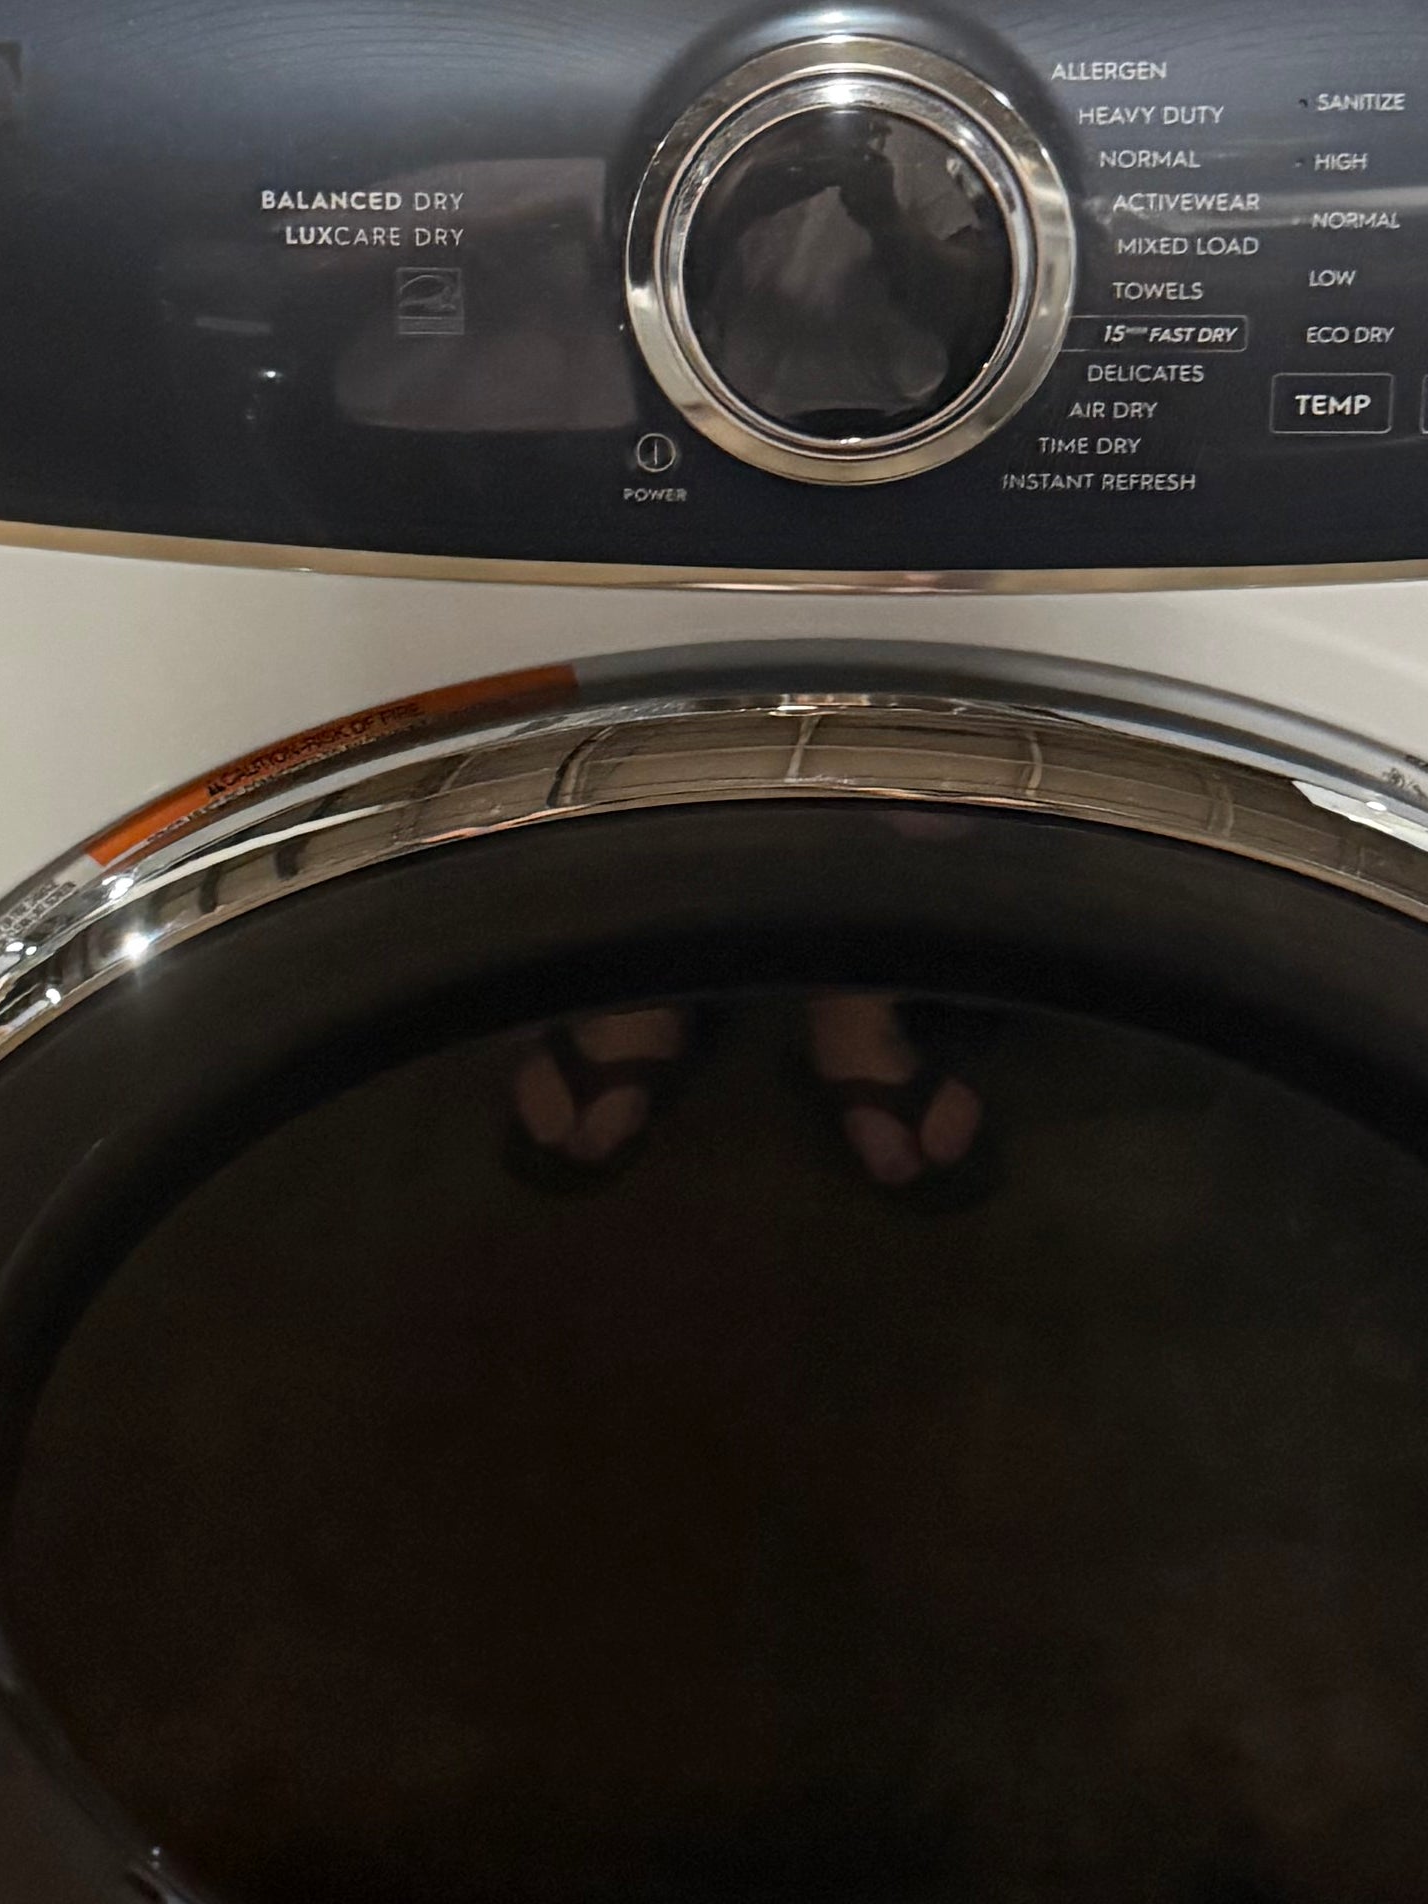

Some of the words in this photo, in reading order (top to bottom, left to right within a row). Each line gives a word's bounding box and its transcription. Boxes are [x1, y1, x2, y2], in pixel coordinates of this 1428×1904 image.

[1051, 62, 1167, 80] ALLERGEN
[1317, 94, 1405, 111] SANITIZE
[1078, 107, 1155, 126] HEAVY
[1163, 106, 1224, 124] DUTY
[1100, 150, 1201, 168] NORMAL
[1315, 153, 1367, 170] HIGH
[261, 191, 402, 211] BALANCED
[414, 193, 465, 211] DRY
[1112, 193, 1260, 211] ACTIVEWEAR
[1312, 212, 1400, 229] NORMAL
[286, 227, 401, 247] LUXCARE
[415, 229, 465, 247] DRY
[1118, 238, 1189, 255] MIXED
[1196, 237, 1259, 255] LOAD
[1309, 270, 1356, 287] LOW
[1112, 282, 1204, 300] TOWELS
[1149, 327, 1196, 343] FAST
[1197, 327, 1238, 343] DRY
[1306, 327, 1350, 344] ECO
[1354, 327, 1394, 344] DRY
[1087, 364, 1205, 382] DELICATES
[1069, 403, 1105, 418] AIR
[1111, 402, 1157, 418] DRY
[1295, 396, 1370, 415] TEMP
[1039, 438, 1089, 454] TIME
[1096, 438, 1141, 454] DRY
[1002, 475, 1094, 490] INSTANT
[1101, 474, 1195, 489] REFRESH
[623, 488, 687, 502] POWER
